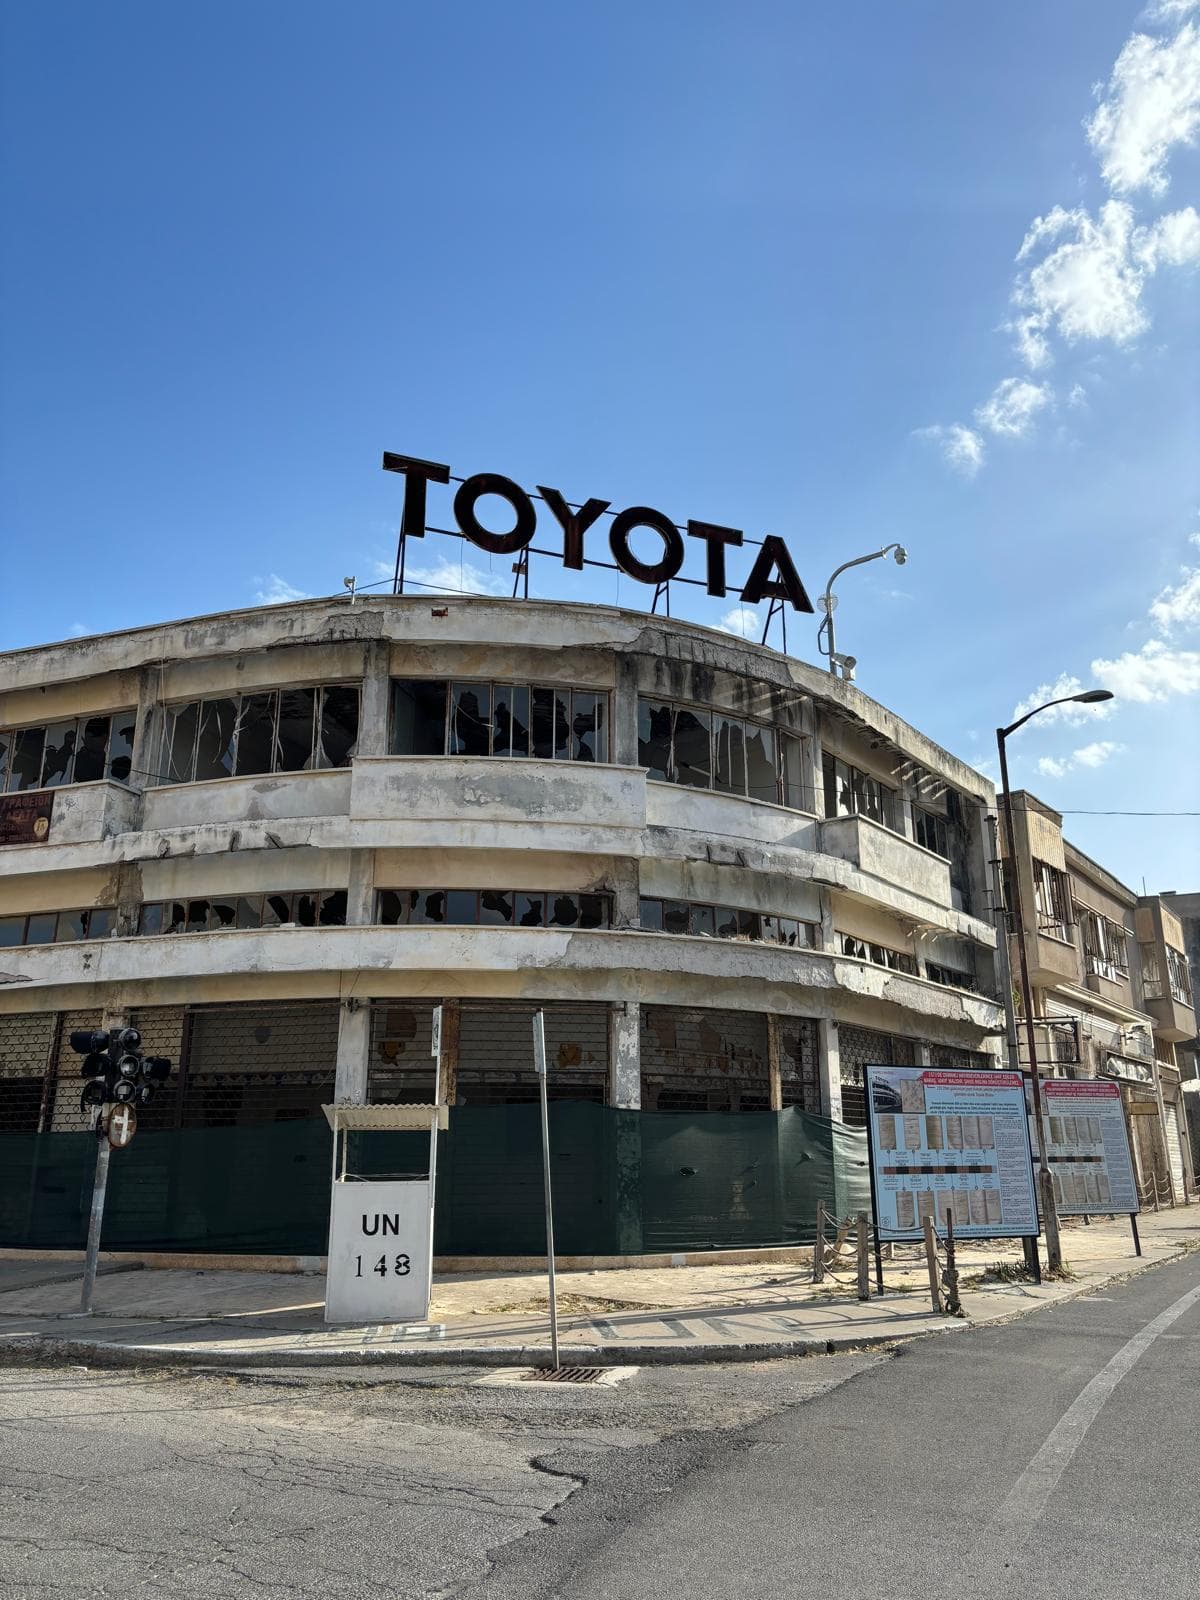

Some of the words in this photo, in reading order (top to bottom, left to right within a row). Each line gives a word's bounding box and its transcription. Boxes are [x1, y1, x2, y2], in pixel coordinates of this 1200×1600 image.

[383, 451, 815, 614] TOYOTA
[362, 1213, 400, 1236] UN
[355, 1253, 411, 1277] 148
